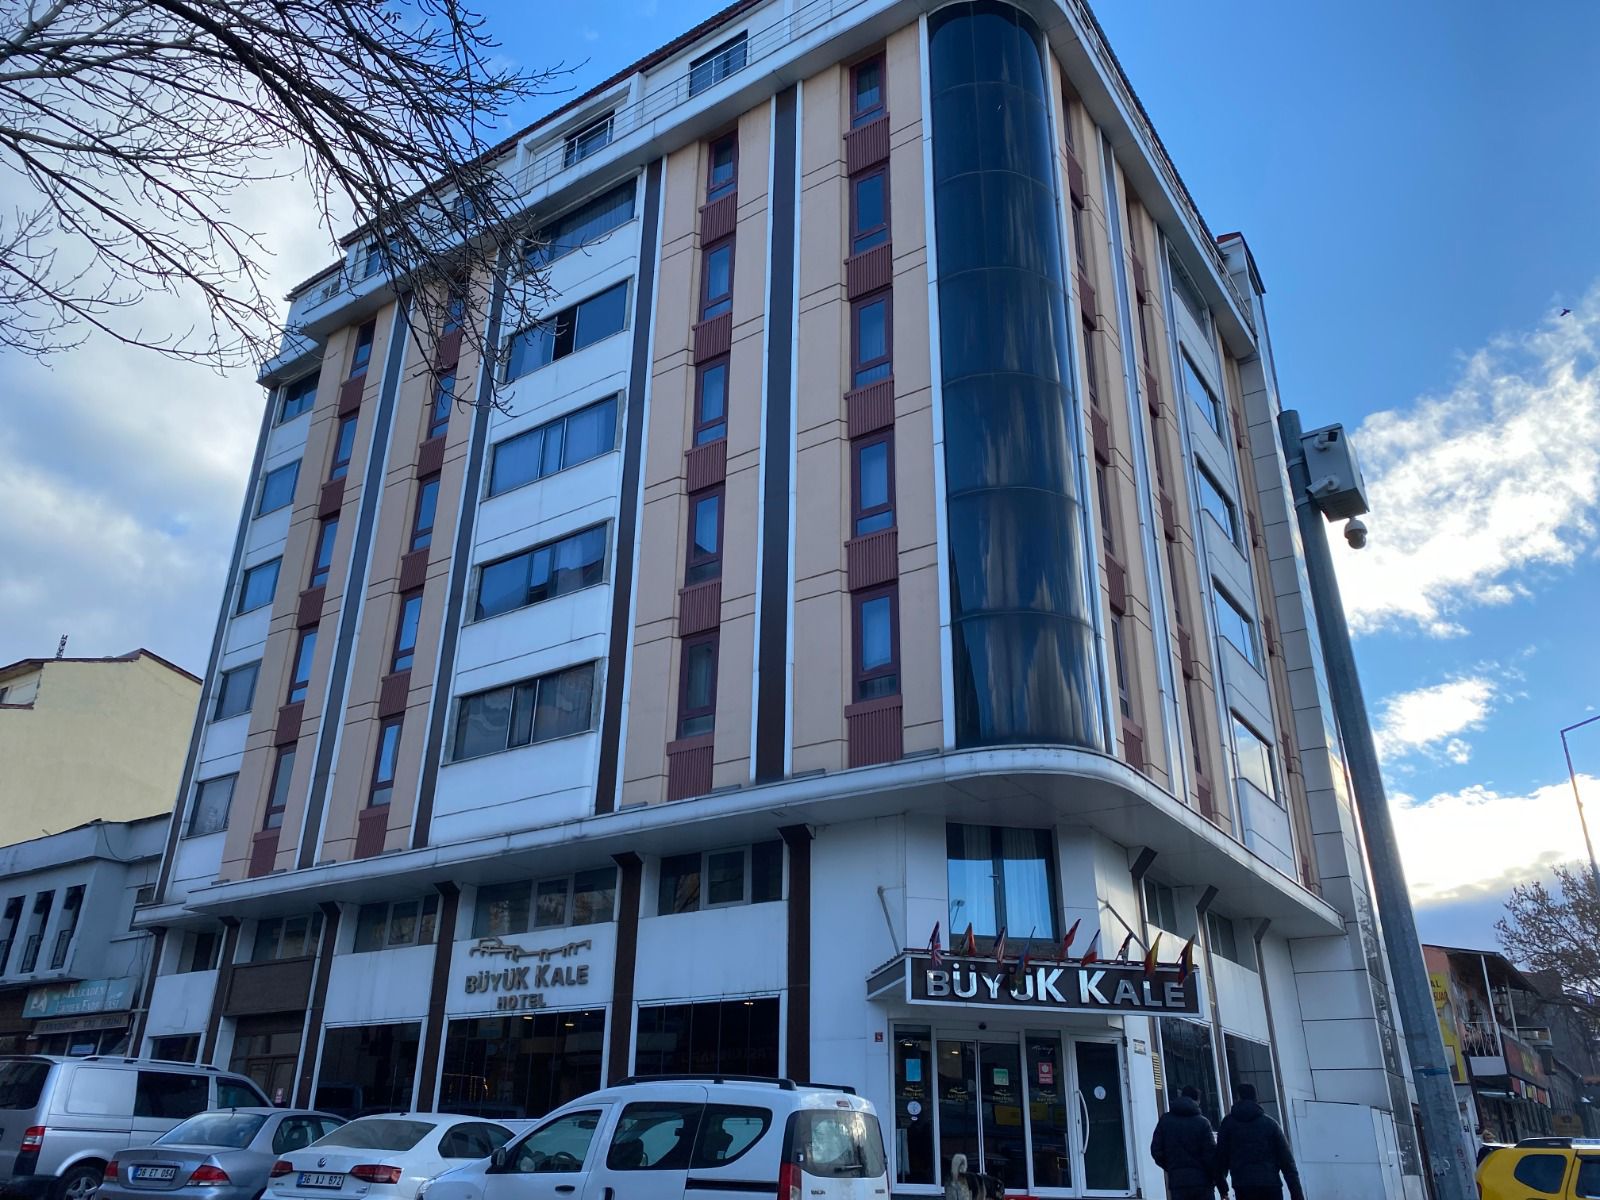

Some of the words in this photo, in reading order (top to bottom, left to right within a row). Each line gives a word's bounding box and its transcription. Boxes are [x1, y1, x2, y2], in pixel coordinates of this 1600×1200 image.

[465, 967, 530, 994] BÜYÜK
[534, 964, 590, 988] KALE
[926, 962, 1067, 1002] BÜYÜK
[1078, 969, 1187, 1008] KALE
[497, 993, 547, 1010] HOTEL
[149, 1168, 158, 1177] ET
[303, 1174, 312, 1184] 36
